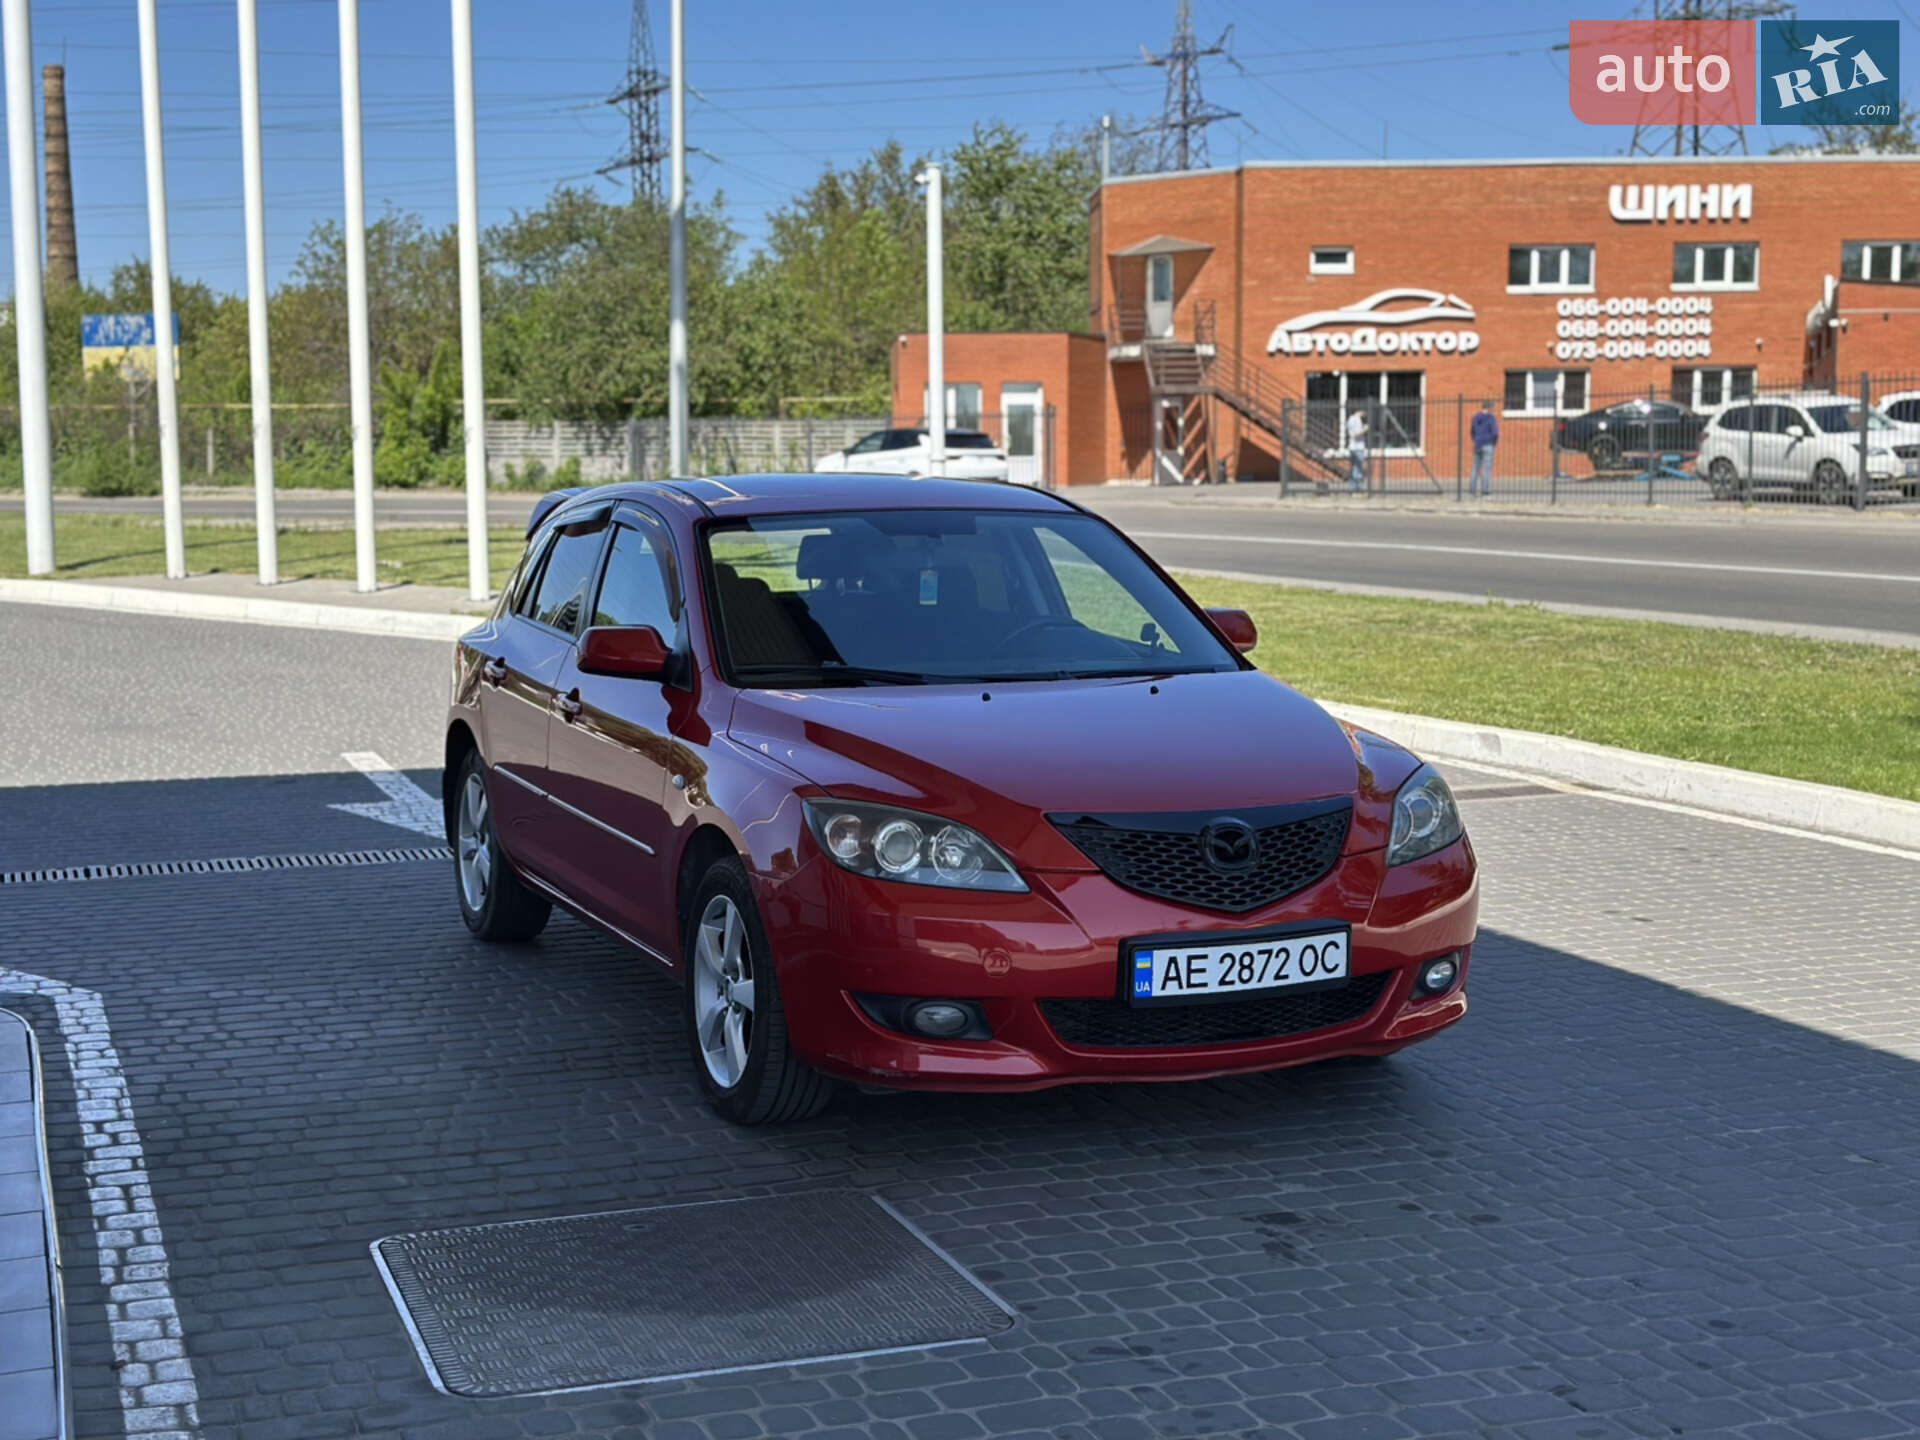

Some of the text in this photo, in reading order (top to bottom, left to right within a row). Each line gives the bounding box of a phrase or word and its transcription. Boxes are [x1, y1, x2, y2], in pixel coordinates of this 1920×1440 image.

[1609, 184, 1752, 221] ШИНИ
[1556, 339, 1712, 360] 073-004-0004
[1160, 940, 1341, 991] AE 2872 OC
[1135, 981, 1151, 993] UA
